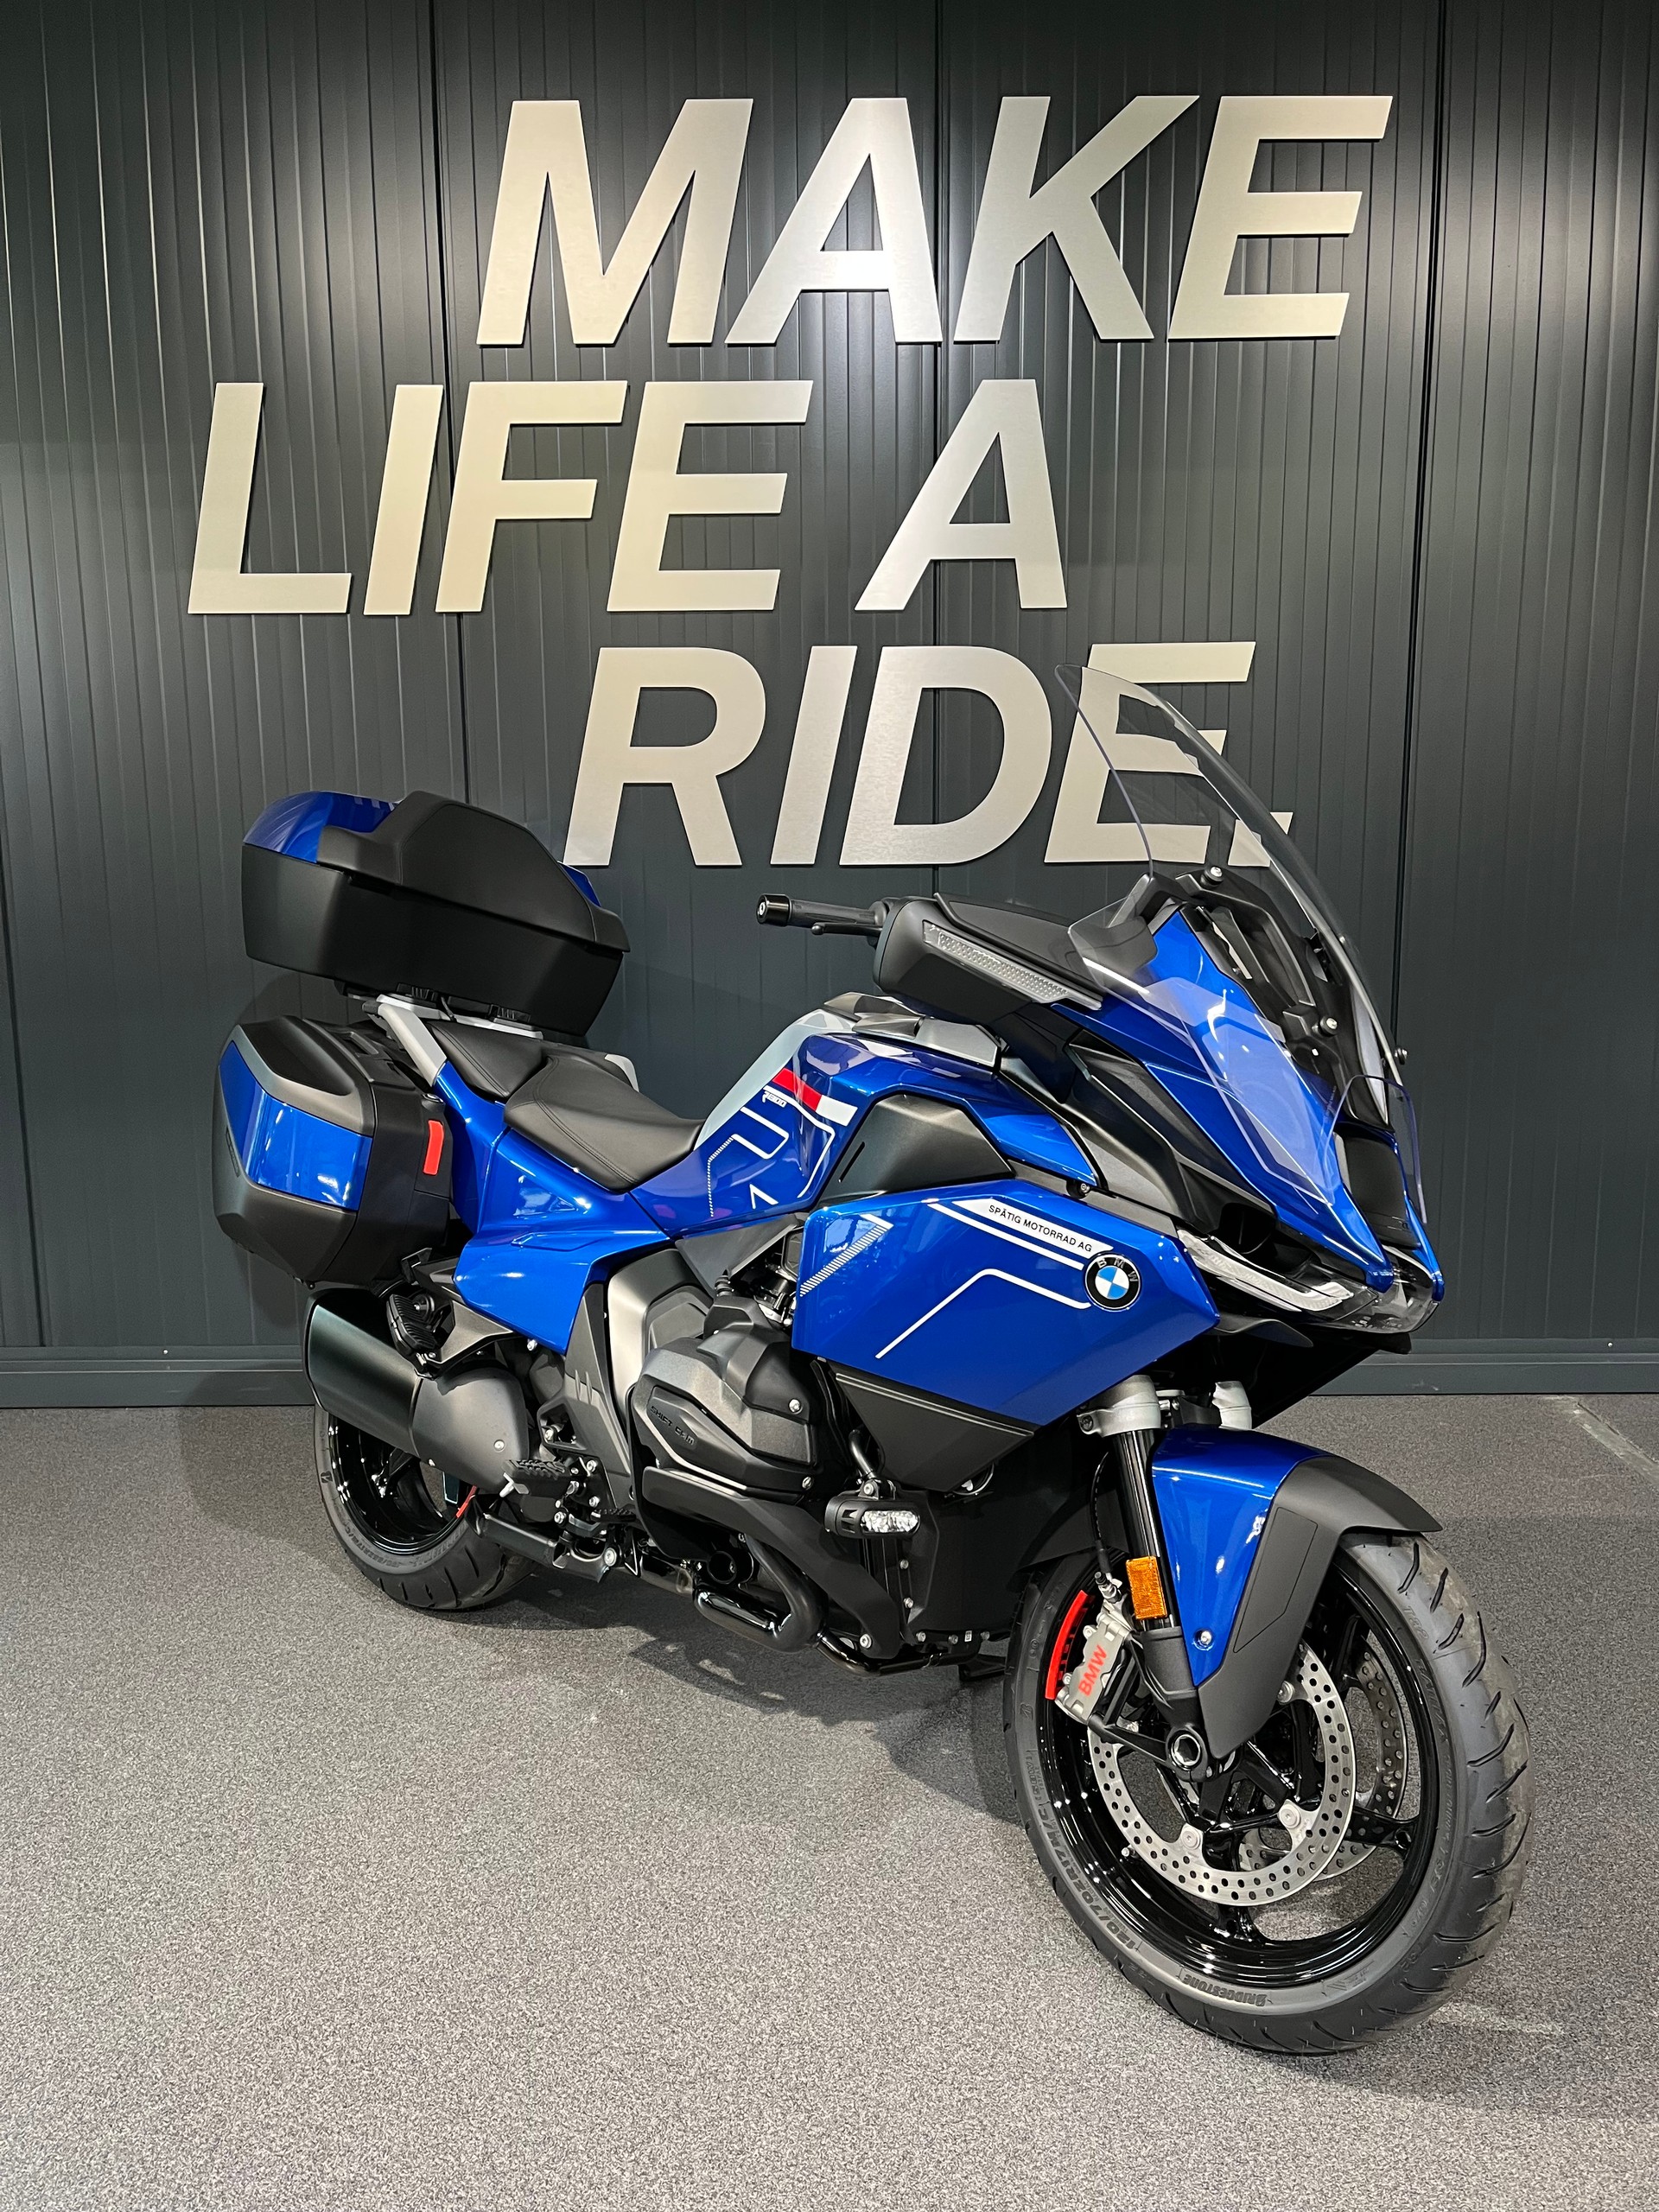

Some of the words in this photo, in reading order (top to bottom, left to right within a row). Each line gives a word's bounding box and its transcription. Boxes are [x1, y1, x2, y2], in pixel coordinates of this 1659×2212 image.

[476, 95, 1393, 346] MAKE
[188, 378, 814, 615] LIFE
[855, 378, 1068, 611] A
[563, 641, 1294, 868] RIDE.
[988, 1205, 1021, 1224] SPÄTIG
[1023, 1218, 1077, 1246] MOTORRAD
[1077, 1242, 1092, 1252] AG
[1096, 1256, 1139, 1283] BMW
[650, 1405, 673, 1427] SHIFT
[1077, 1644, 1107, 1697] BMW
[1182, 1974, 1267, 2006] BRIDGESTONE
